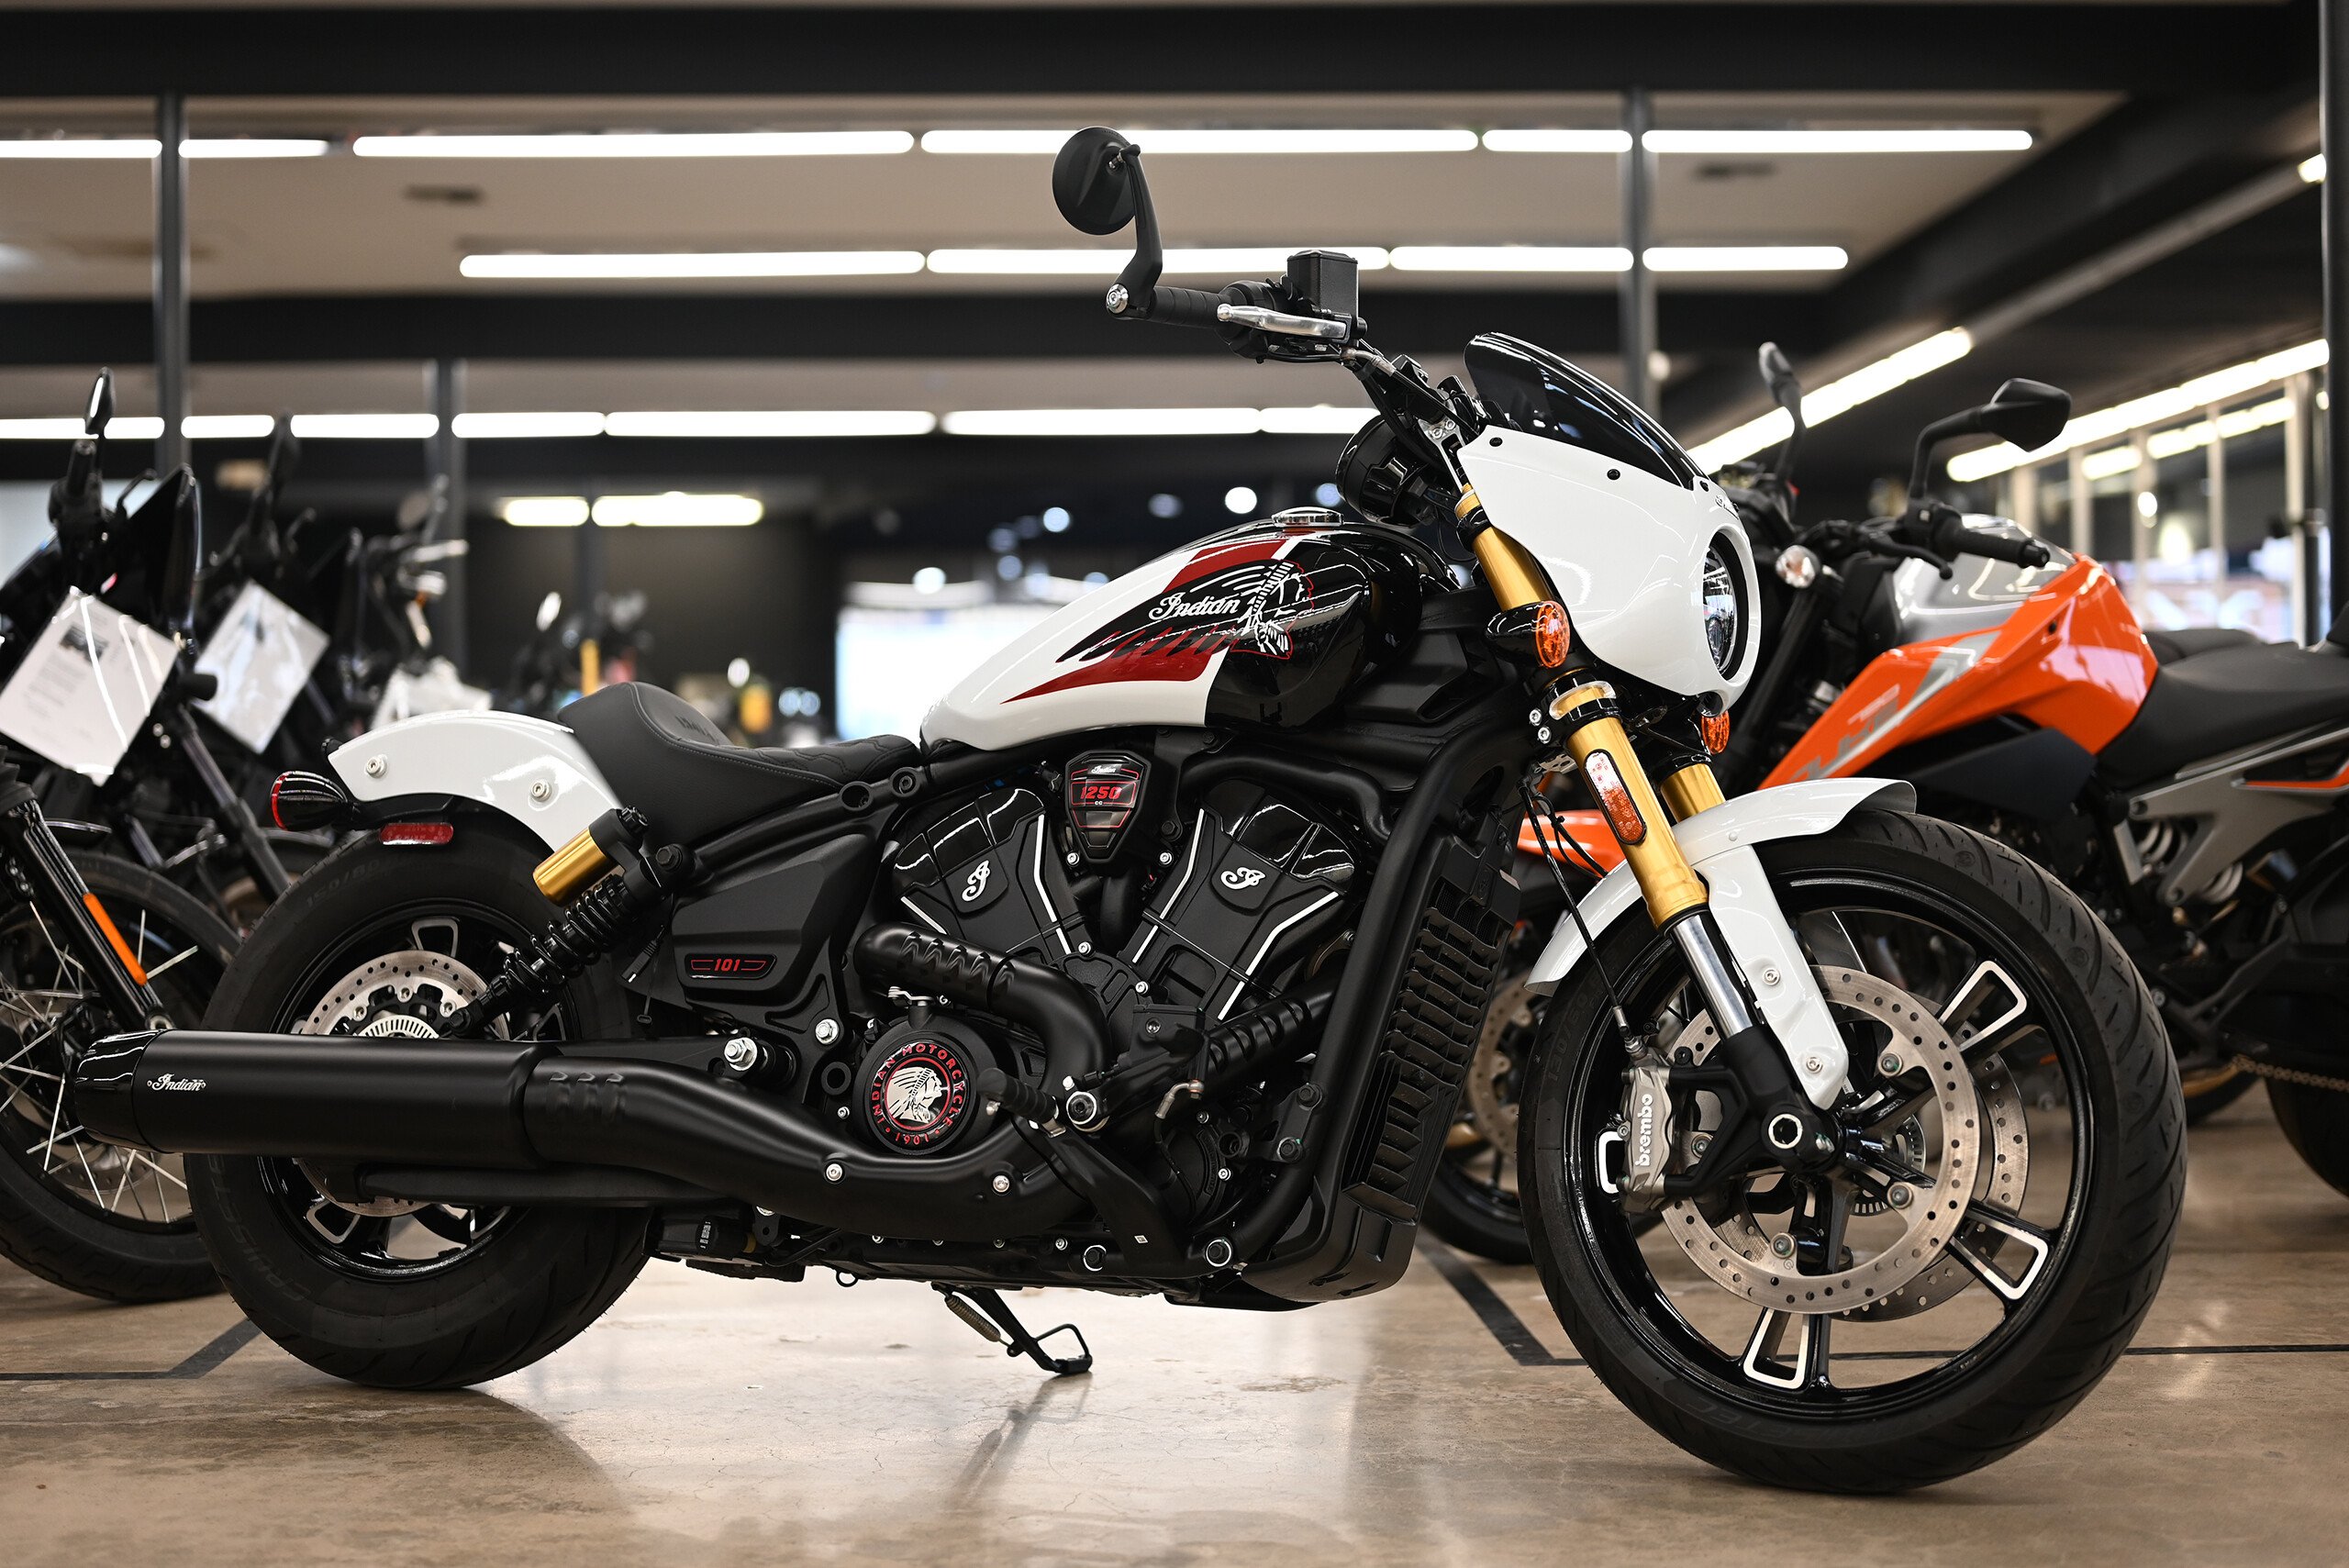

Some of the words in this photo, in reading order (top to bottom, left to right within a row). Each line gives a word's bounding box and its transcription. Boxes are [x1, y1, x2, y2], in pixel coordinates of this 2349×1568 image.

[1148, 592, 1241, 620] Indian
[1090, 765, 1117, 774] Indian
[1080, 785, 1122, 799] 1250
[714, 958, 740, 972] 101
[151, 1073, 202, 1092] Indian
[872, 1057, 896, 1125] INDIAN
[901, 1043, 964, 1127] MOTORCYCLE
[1635, 1093, 1653, 1166] brembo
